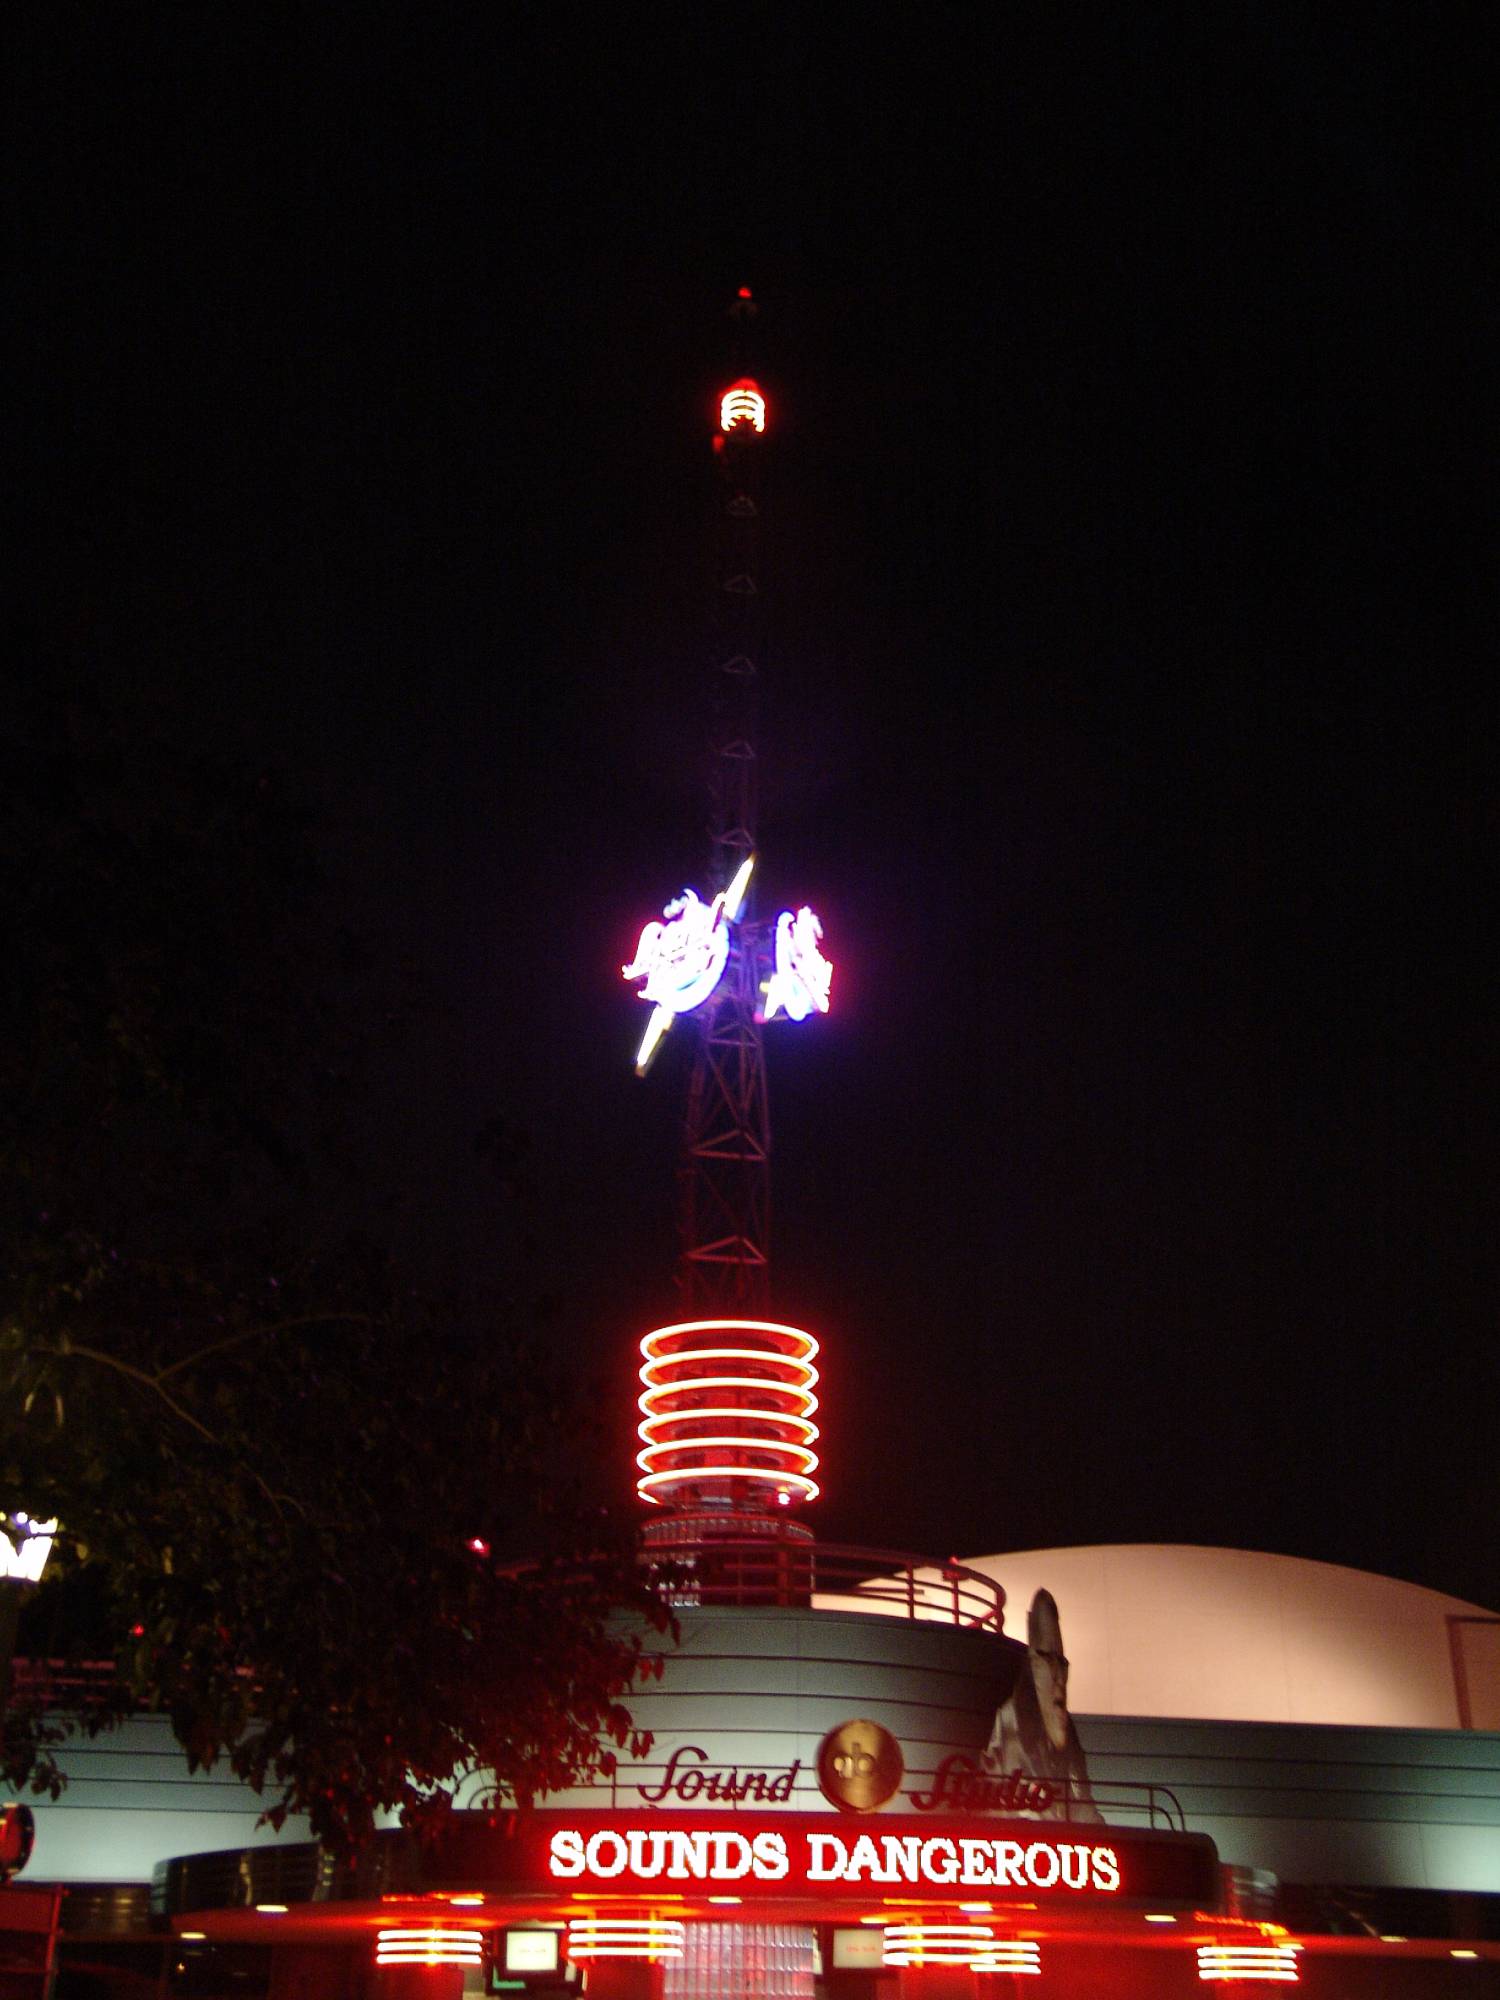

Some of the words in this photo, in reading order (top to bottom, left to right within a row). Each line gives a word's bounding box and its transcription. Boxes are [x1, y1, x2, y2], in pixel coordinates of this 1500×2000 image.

[637, 1746, 801, 1801] Sound
[910, 1754, 1054, 1811] Studio
[549, 1829, 790, 1880] SOUNDS
[806, 1833, 1121, 1891] DANGEROUS
